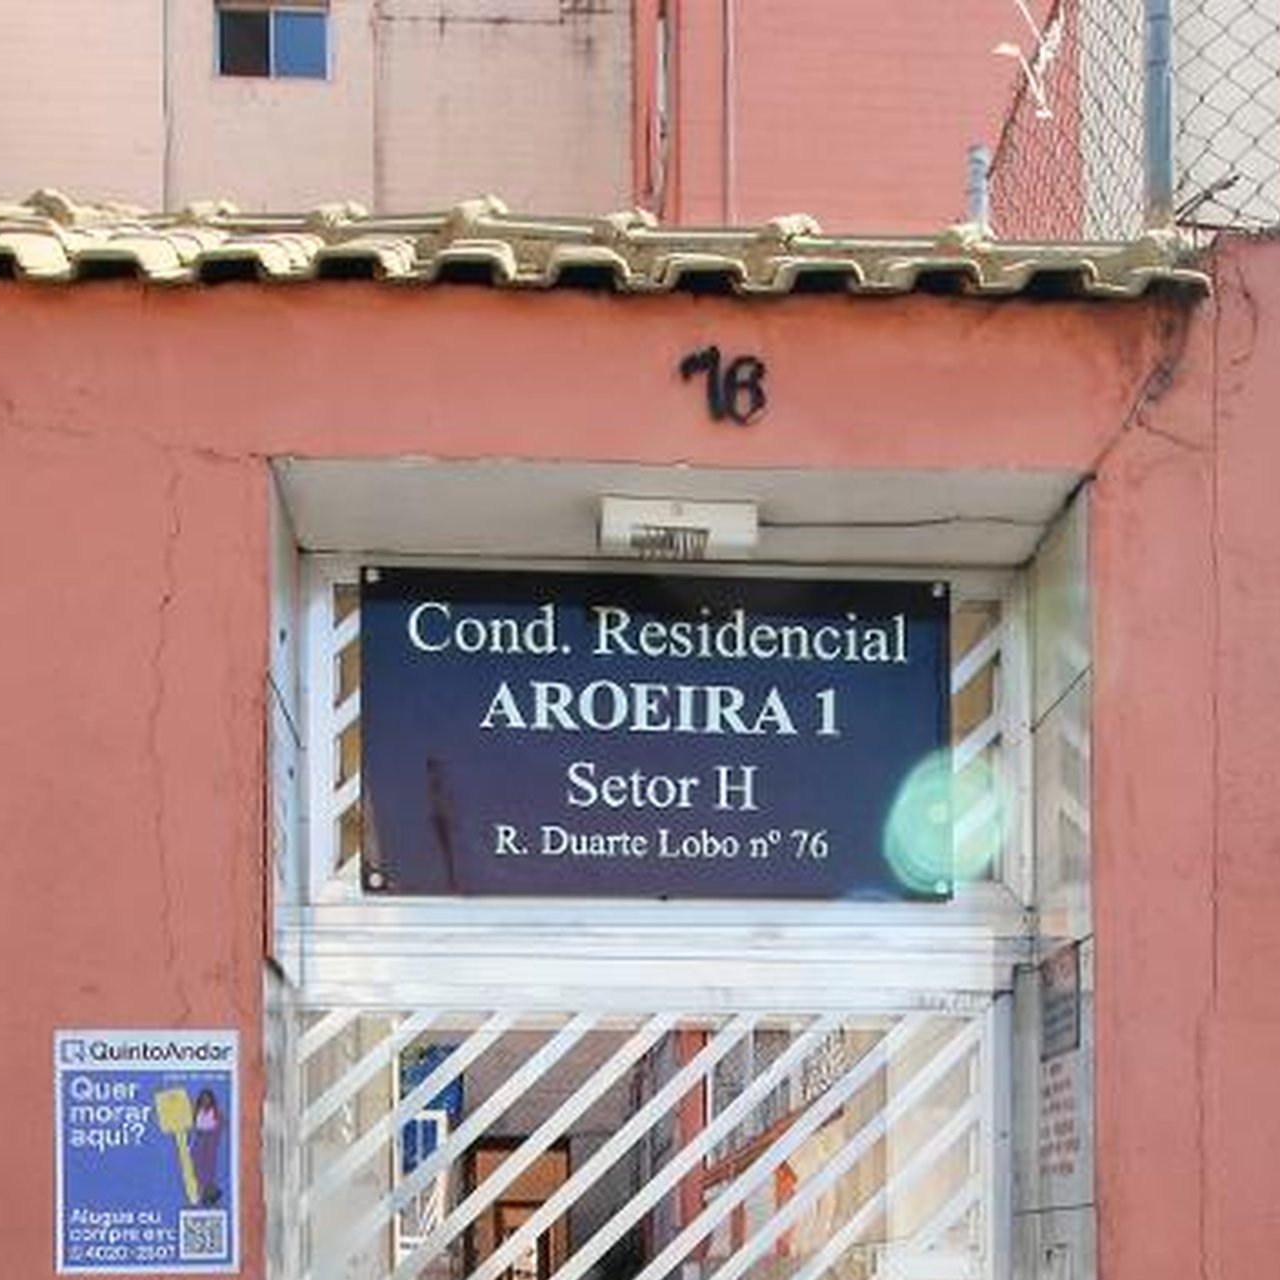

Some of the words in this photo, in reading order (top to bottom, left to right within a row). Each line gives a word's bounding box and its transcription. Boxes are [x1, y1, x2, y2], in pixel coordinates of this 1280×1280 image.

[408, 602, 571, 655] Cond.
[592, 606, 908, 663] Residencial
[479, 680, 798, 735] AROEIRA
[816, 689, 841, 736] 1
[567, 761, 700, 808] Setor
[714, 765, 759, 811] H
[495, 824, 529, 856] R.
[540, 825, 648, 857] Duarte
[658, 829, 740, 859] Lobo
[790, 829, 829, 859] 76
[90, 1042, 233, 1062] QuintoAndar
[71, 1075, 138, 1101] Quer
[71, 1105, 152, 1124] morar
[71, 1122, 146, 1153] aqui?
